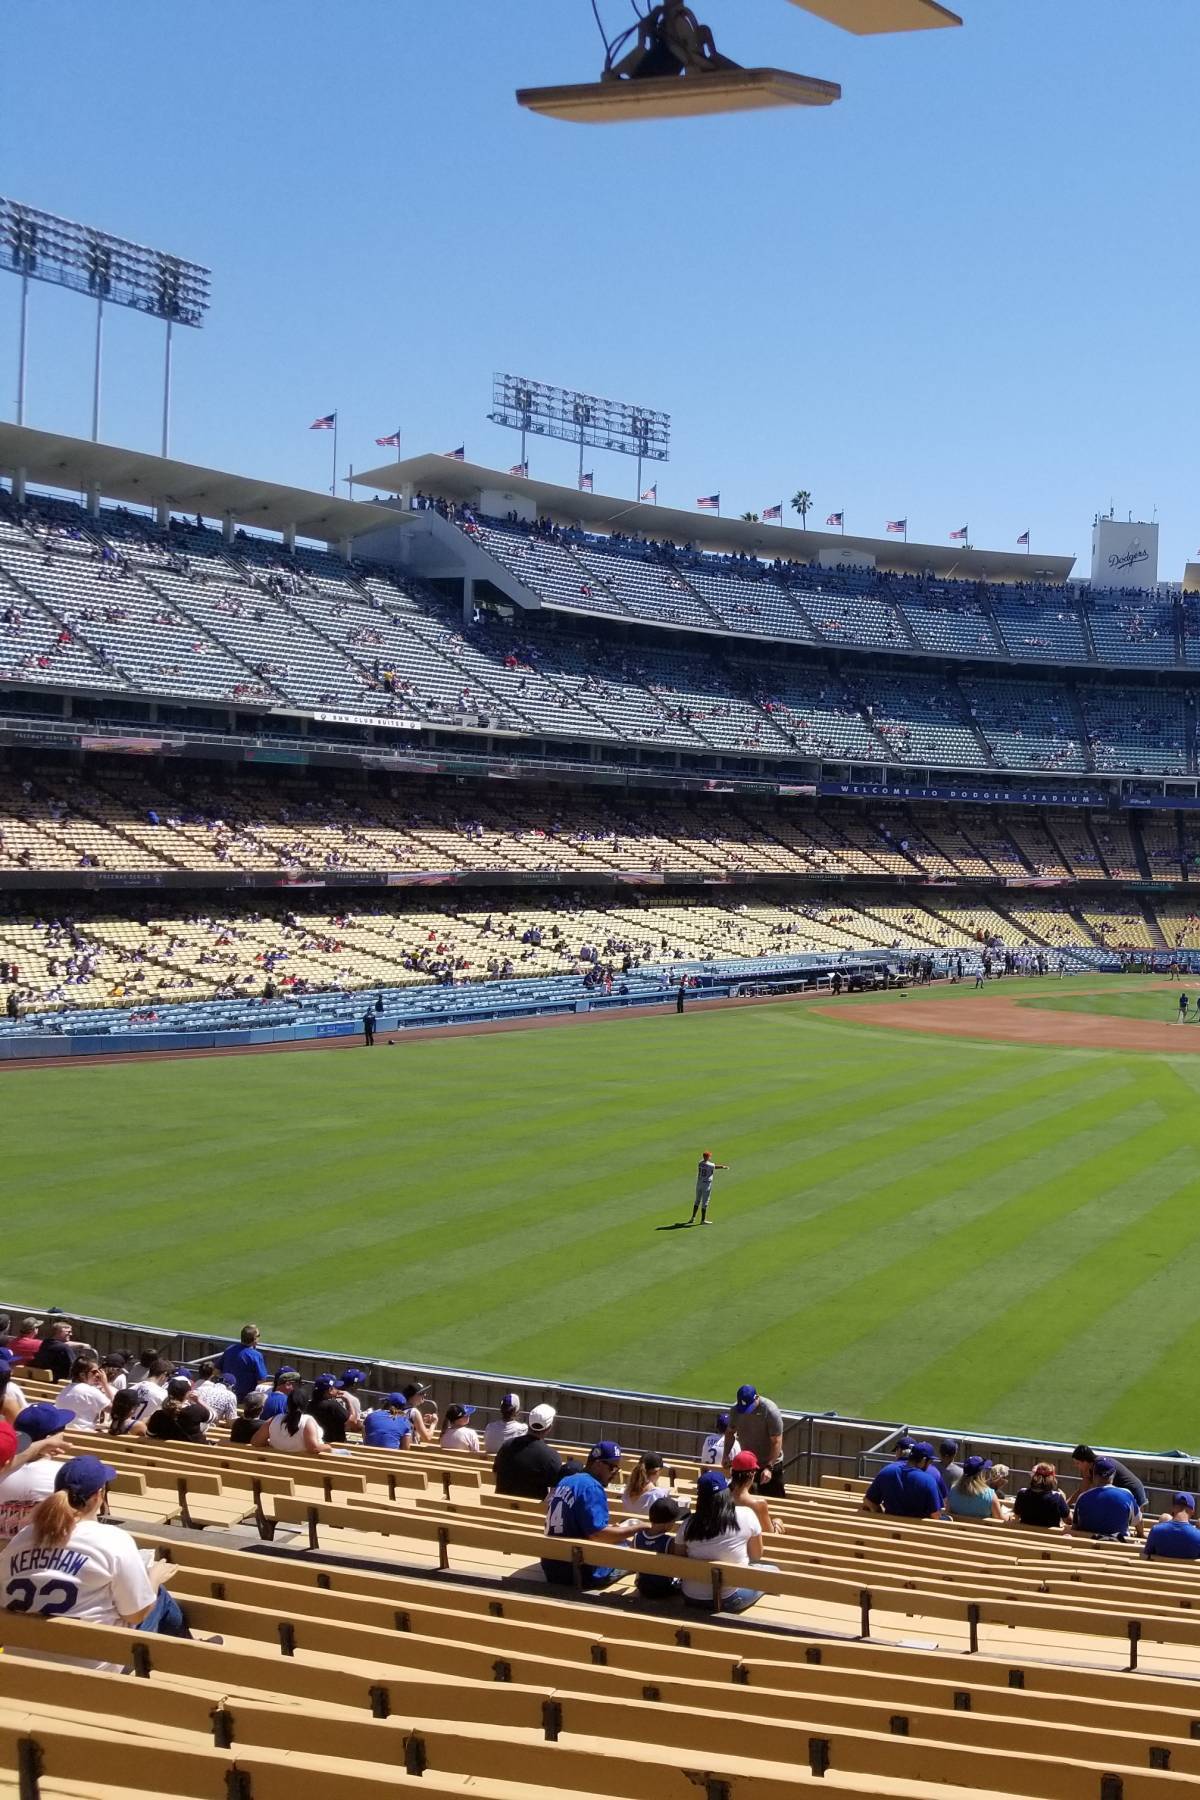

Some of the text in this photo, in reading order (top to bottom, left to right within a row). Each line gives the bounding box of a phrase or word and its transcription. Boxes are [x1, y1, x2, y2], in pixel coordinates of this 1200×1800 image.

[1108, 549, 1148, 569] Dodgers
[840, 785, 1089, 803] WELCOME TO DODGER STADIUM
[706, 1448, 717, 1465] 3
[10, 1547, 89, 1577] KERSHAW
[6, 1578, 79, 1615] 22
